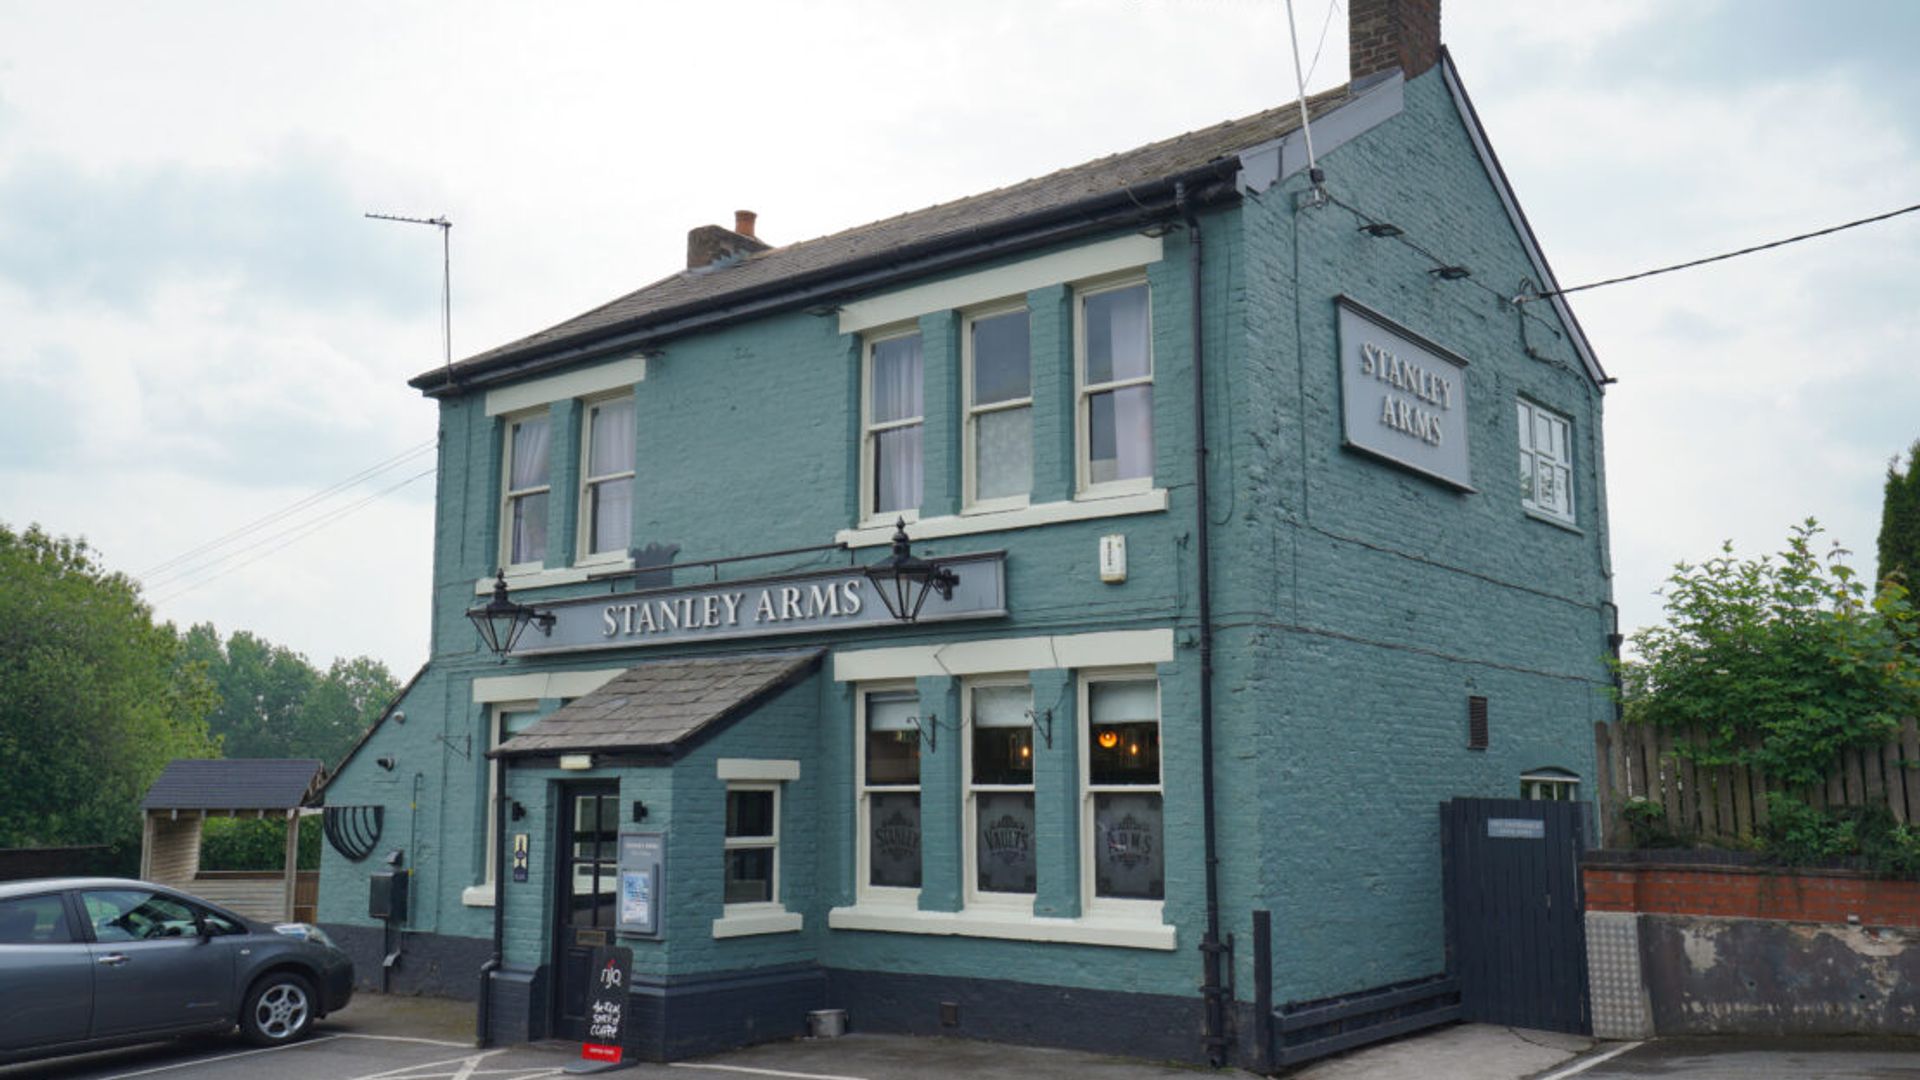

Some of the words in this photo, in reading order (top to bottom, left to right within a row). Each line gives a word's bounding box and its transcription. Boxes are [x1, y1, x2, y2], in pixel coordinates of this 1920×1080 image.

[1361, 342, 1451, 409] STANLEY
[1381, 394, 1442, 446] ARMS
[603, 592, 744, 637] STANLEY
[755, 579, 862, 621] ARMS
